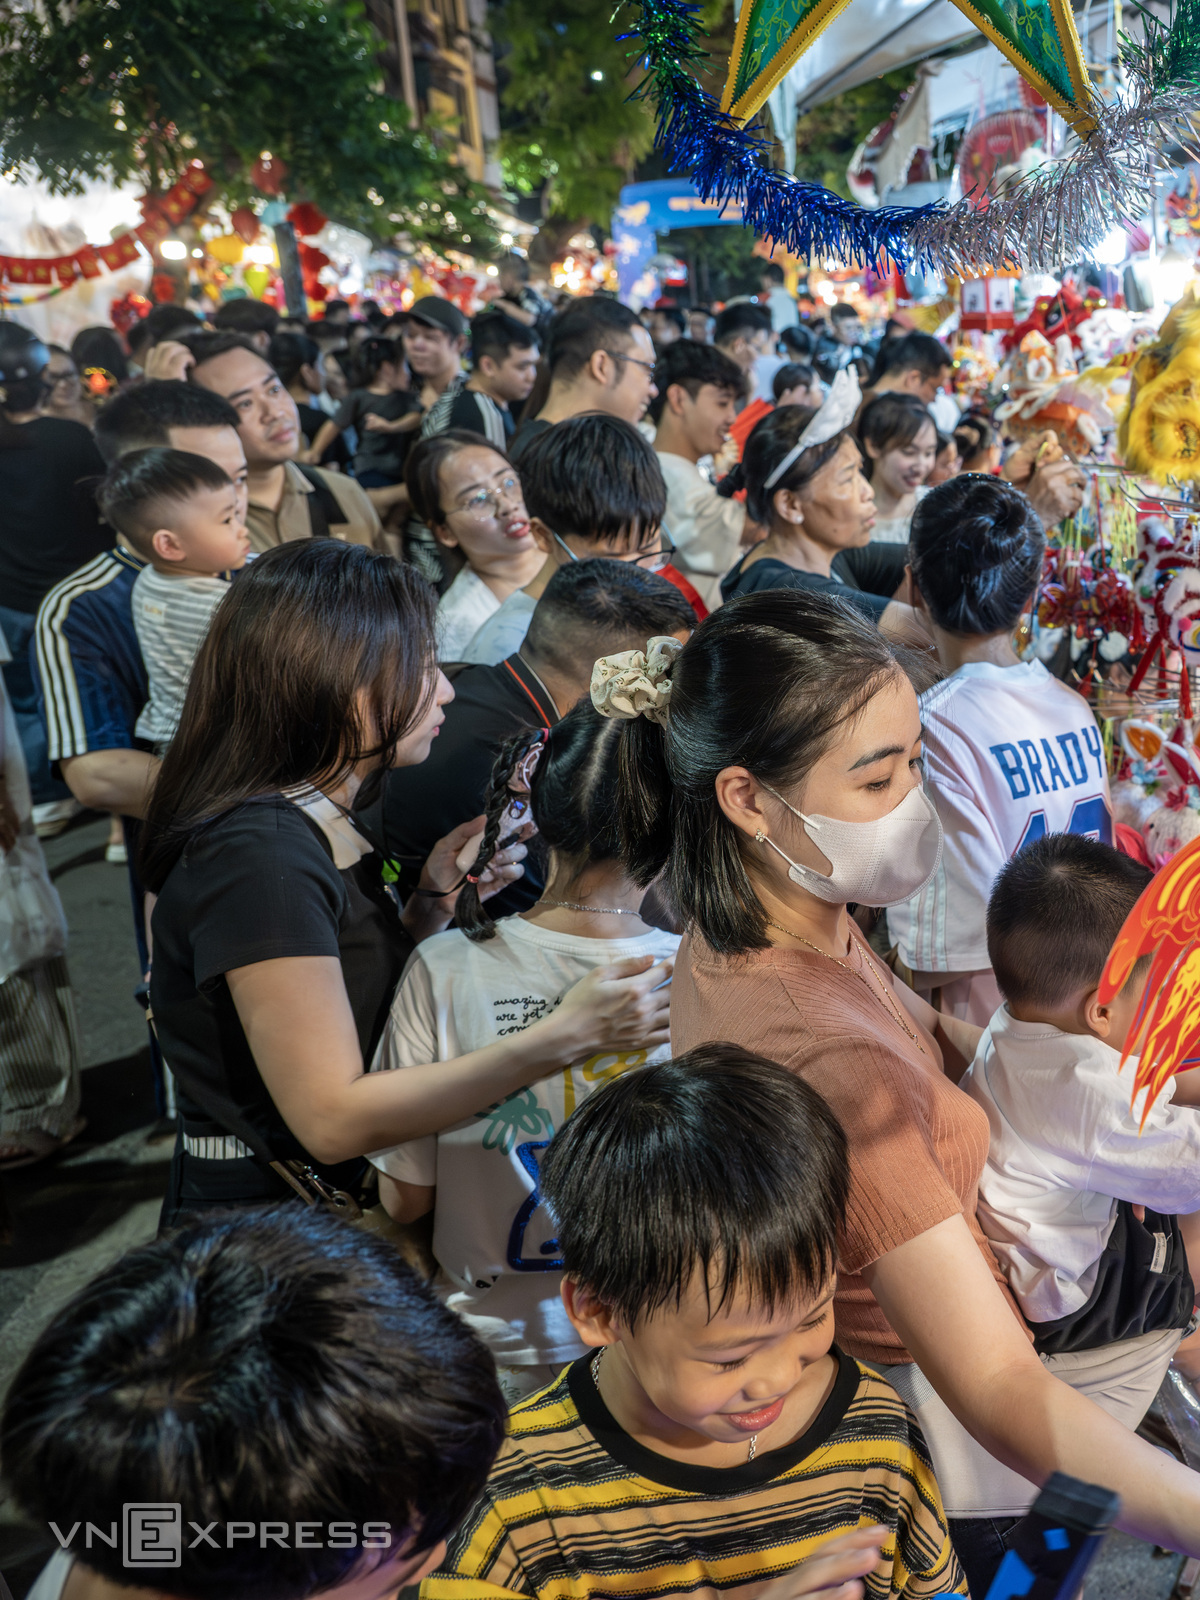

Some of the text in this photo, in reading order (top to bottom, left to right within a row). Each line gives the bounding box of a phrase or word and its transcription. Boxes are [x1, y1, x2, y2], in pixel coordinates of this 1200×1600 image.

[989, 725, 1103, 800] BRADY
[493, 996, 548, 1010] amazing
[496, 1007, 543, 1024] are yet
